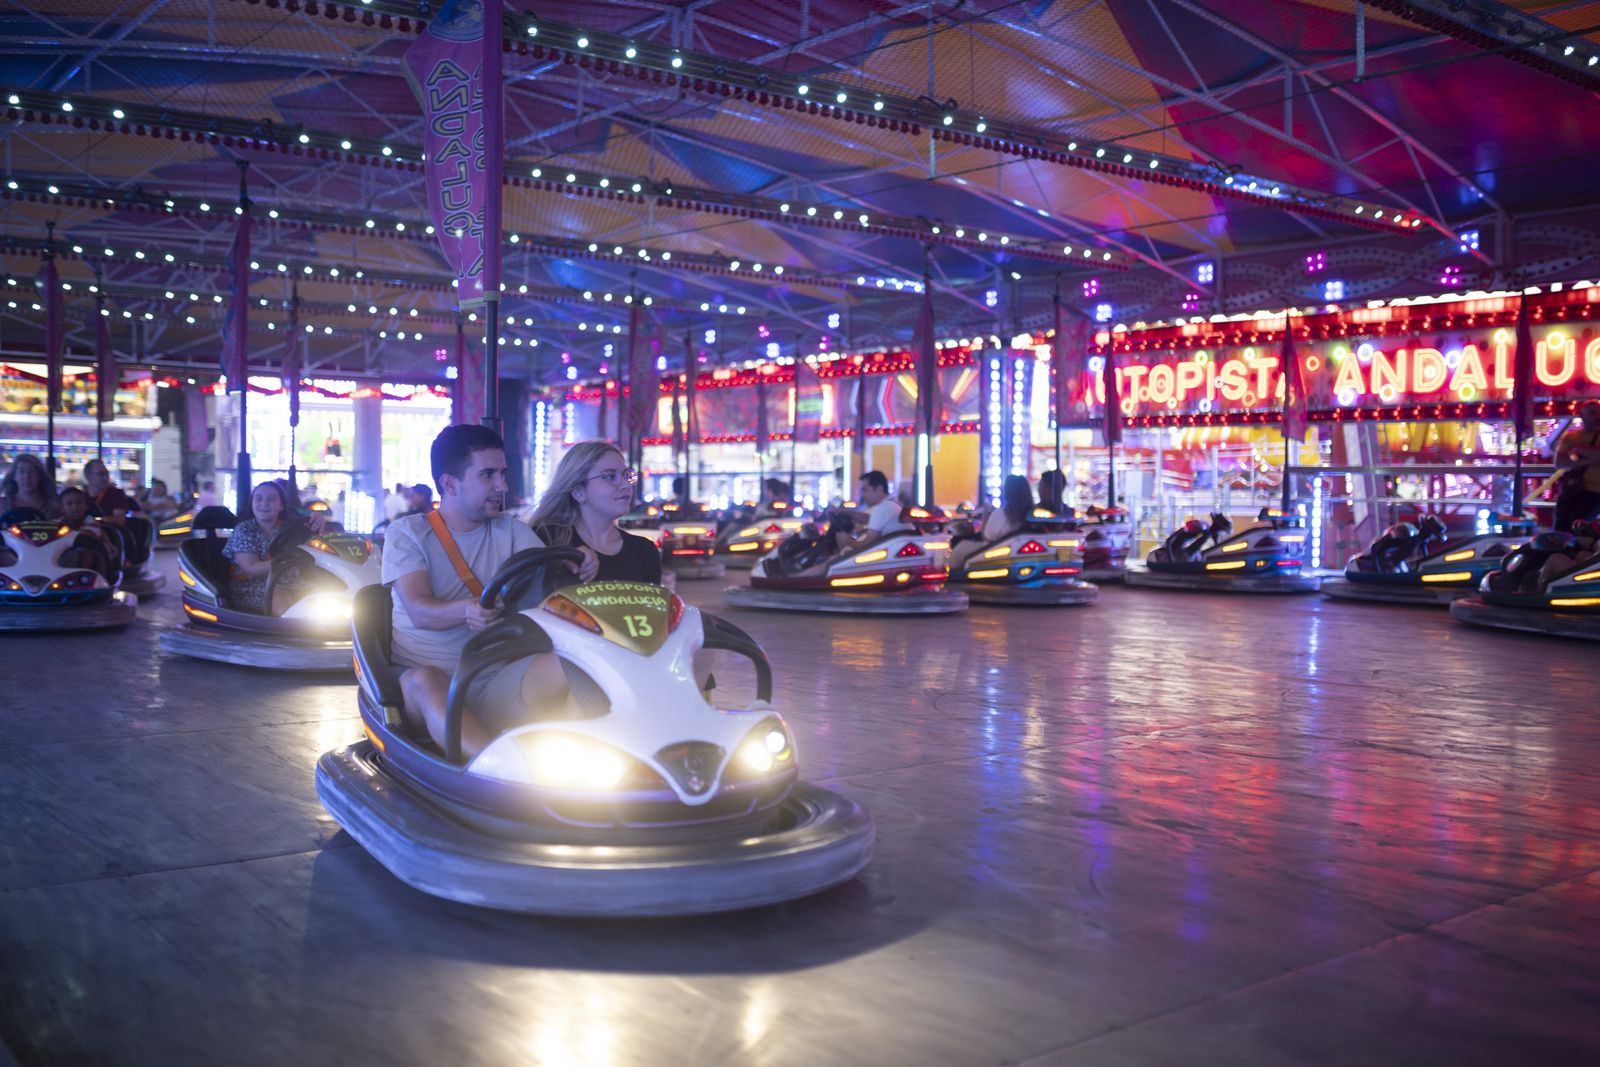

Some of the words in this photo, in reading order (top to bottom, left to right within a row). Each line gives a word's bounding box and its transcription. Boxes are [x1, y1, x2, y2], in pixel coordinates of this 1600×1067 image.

[32, 532, 48, 541] 20
[347, 545, 363, 557] 12
[576, 583, 662, 595] AUTOSPORT
[586, 595, 667, 606] ANDALUCIA
[623, 615, 653, 637] 13
